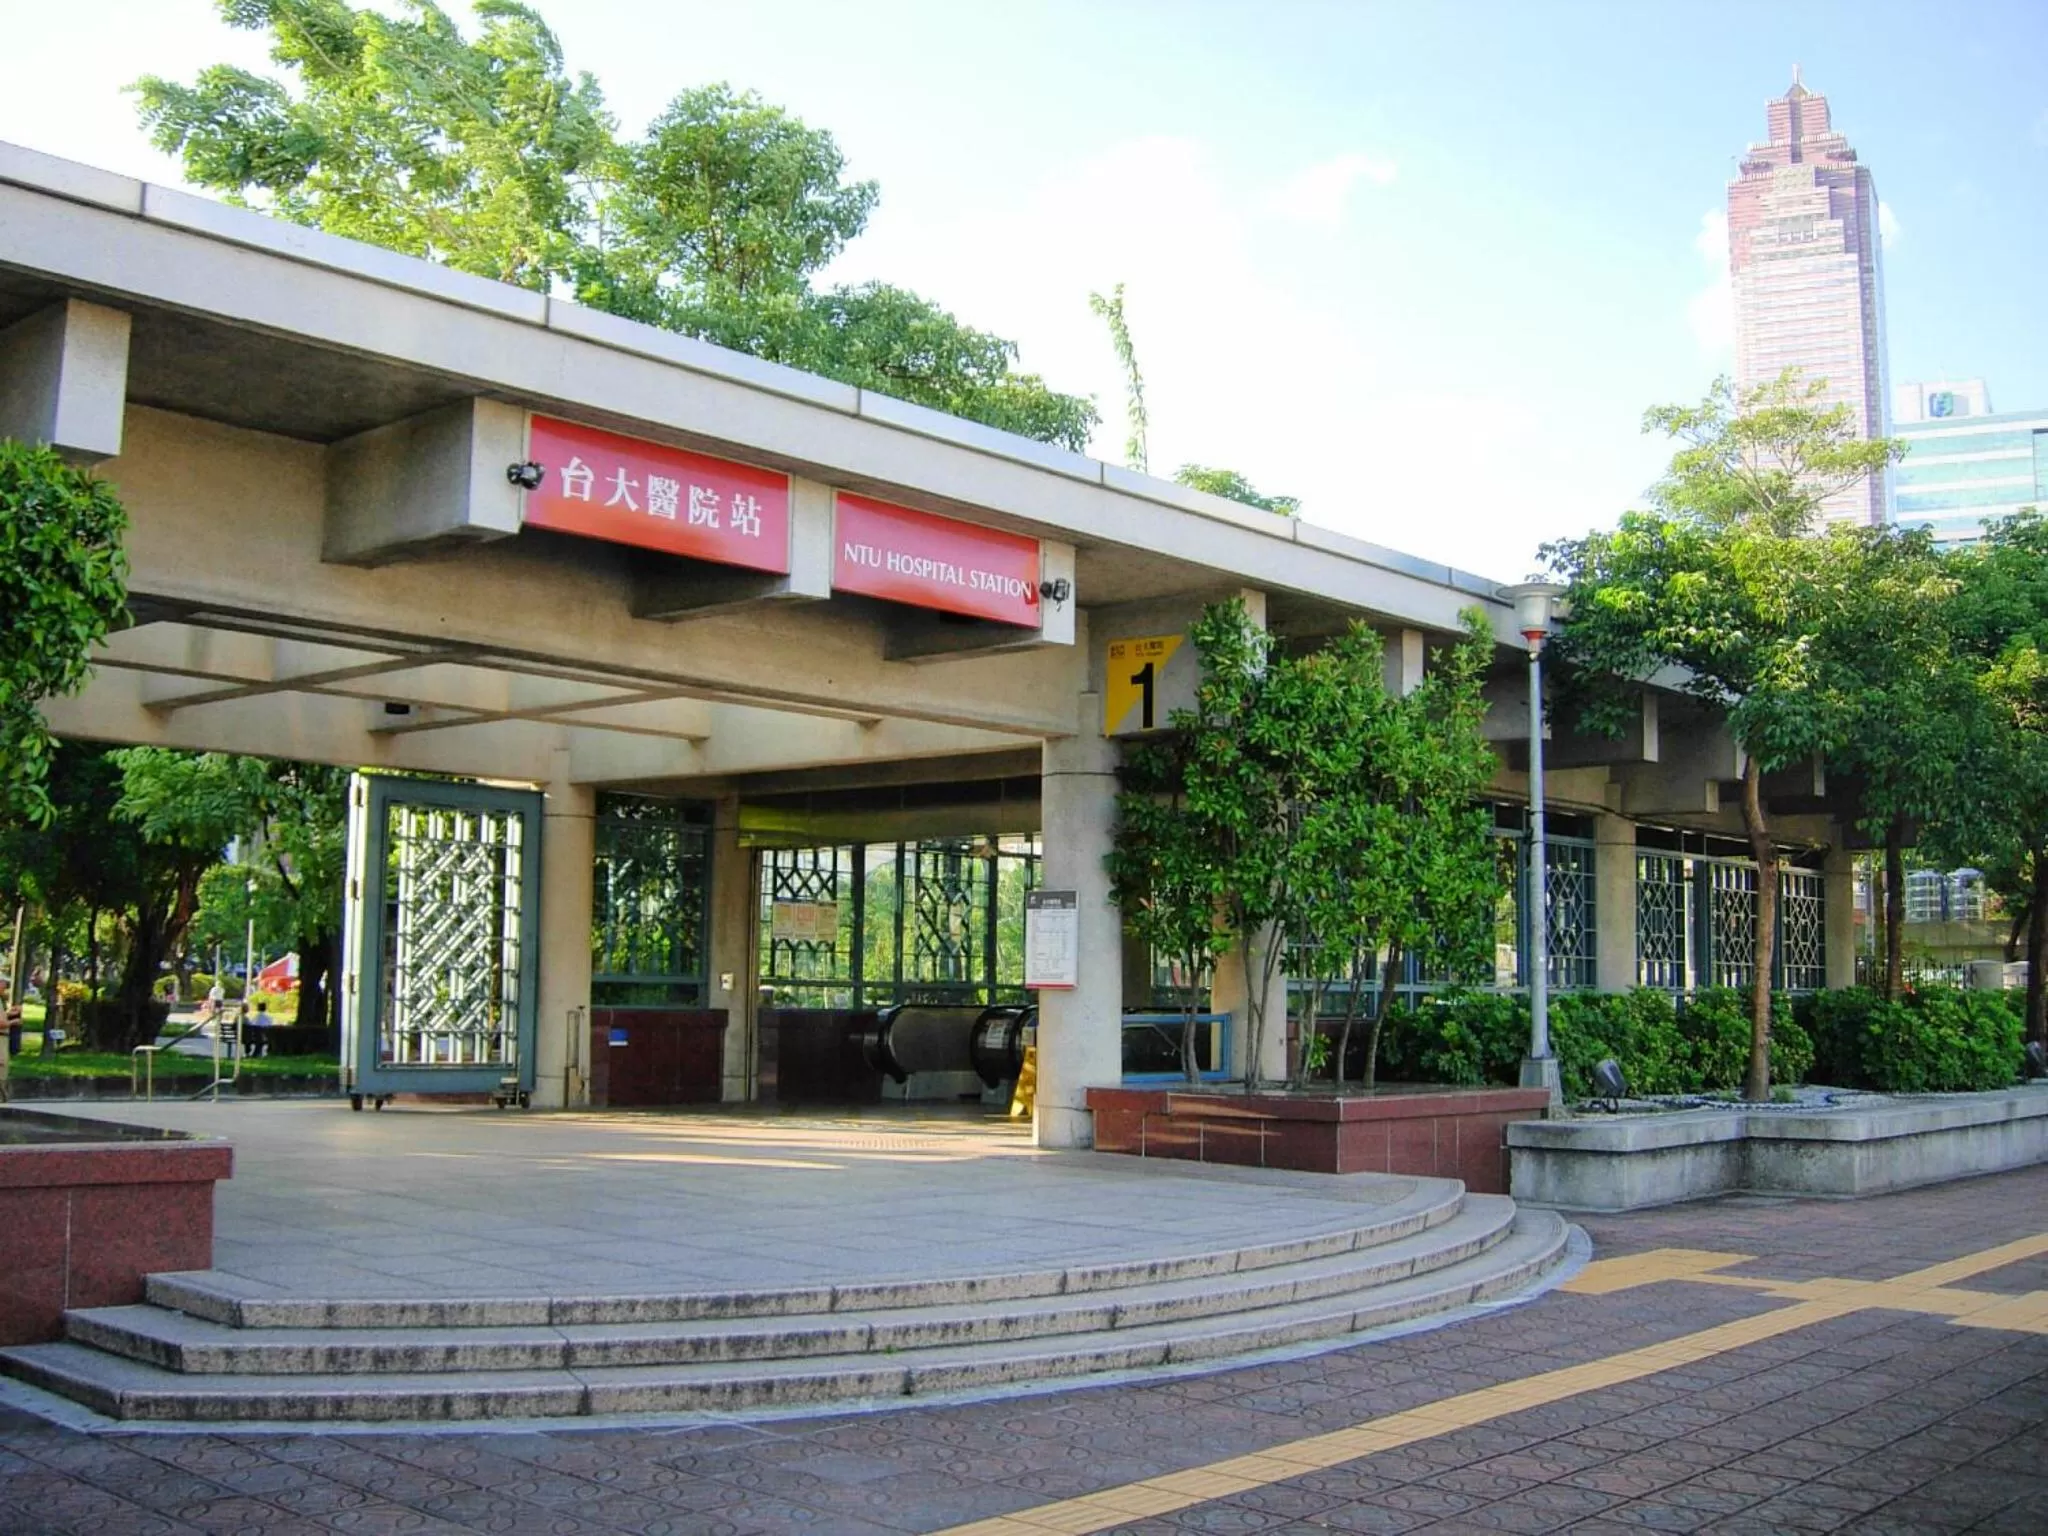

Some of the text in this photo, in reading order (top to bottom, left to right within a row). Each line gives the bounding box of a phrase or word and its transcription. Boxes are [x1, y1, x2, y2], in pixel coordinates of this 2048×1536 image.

[560, 456, 762, 537] 台大醫院站
[844, 543, 1032, 599] NTU HOSPITAL STATION
[1130, 663, 1153, 729] 1
